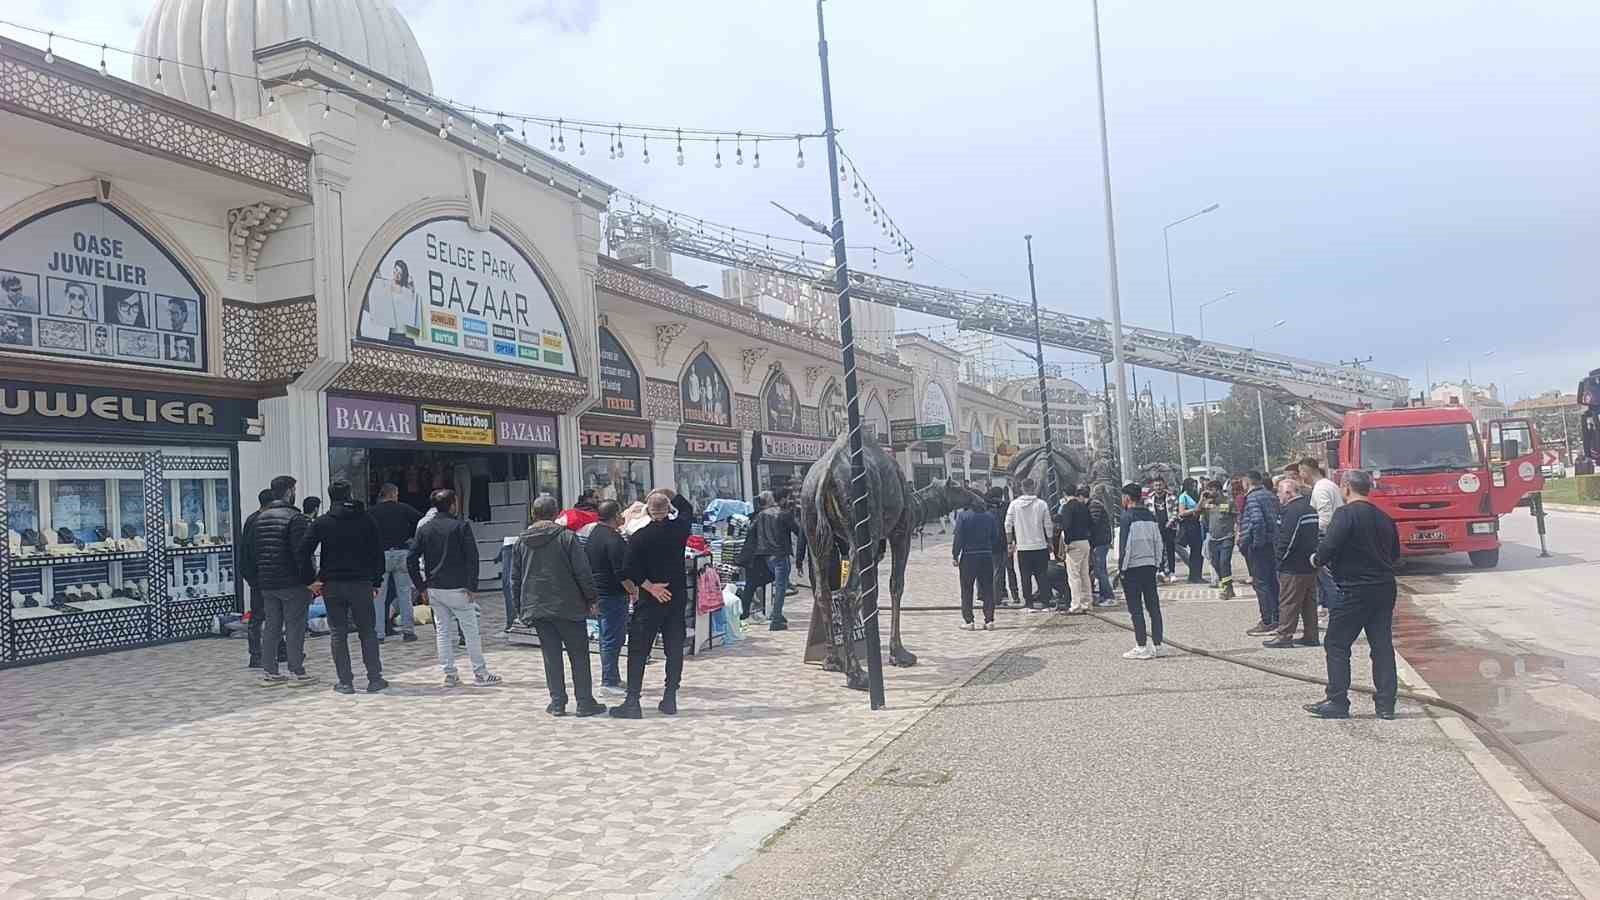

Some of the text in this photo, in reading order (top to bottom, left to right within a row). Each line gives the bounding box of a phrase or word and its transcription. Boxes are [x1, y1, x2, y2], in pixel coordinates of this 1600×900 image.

[73, 231, 123, 259] OASE
[426, 233, 517, 283] SELGE PARK
[48, 251, 147, 286] JUWELIER
[428, 270, 529, 326] BAZAAR
[335, 407, 412, 434] BAZAAR
[500, 421, 552, 442] BAZAAR
[580, 430, 646, 449] STEFAN
[685, 438, 738, 454] TEXTILE
